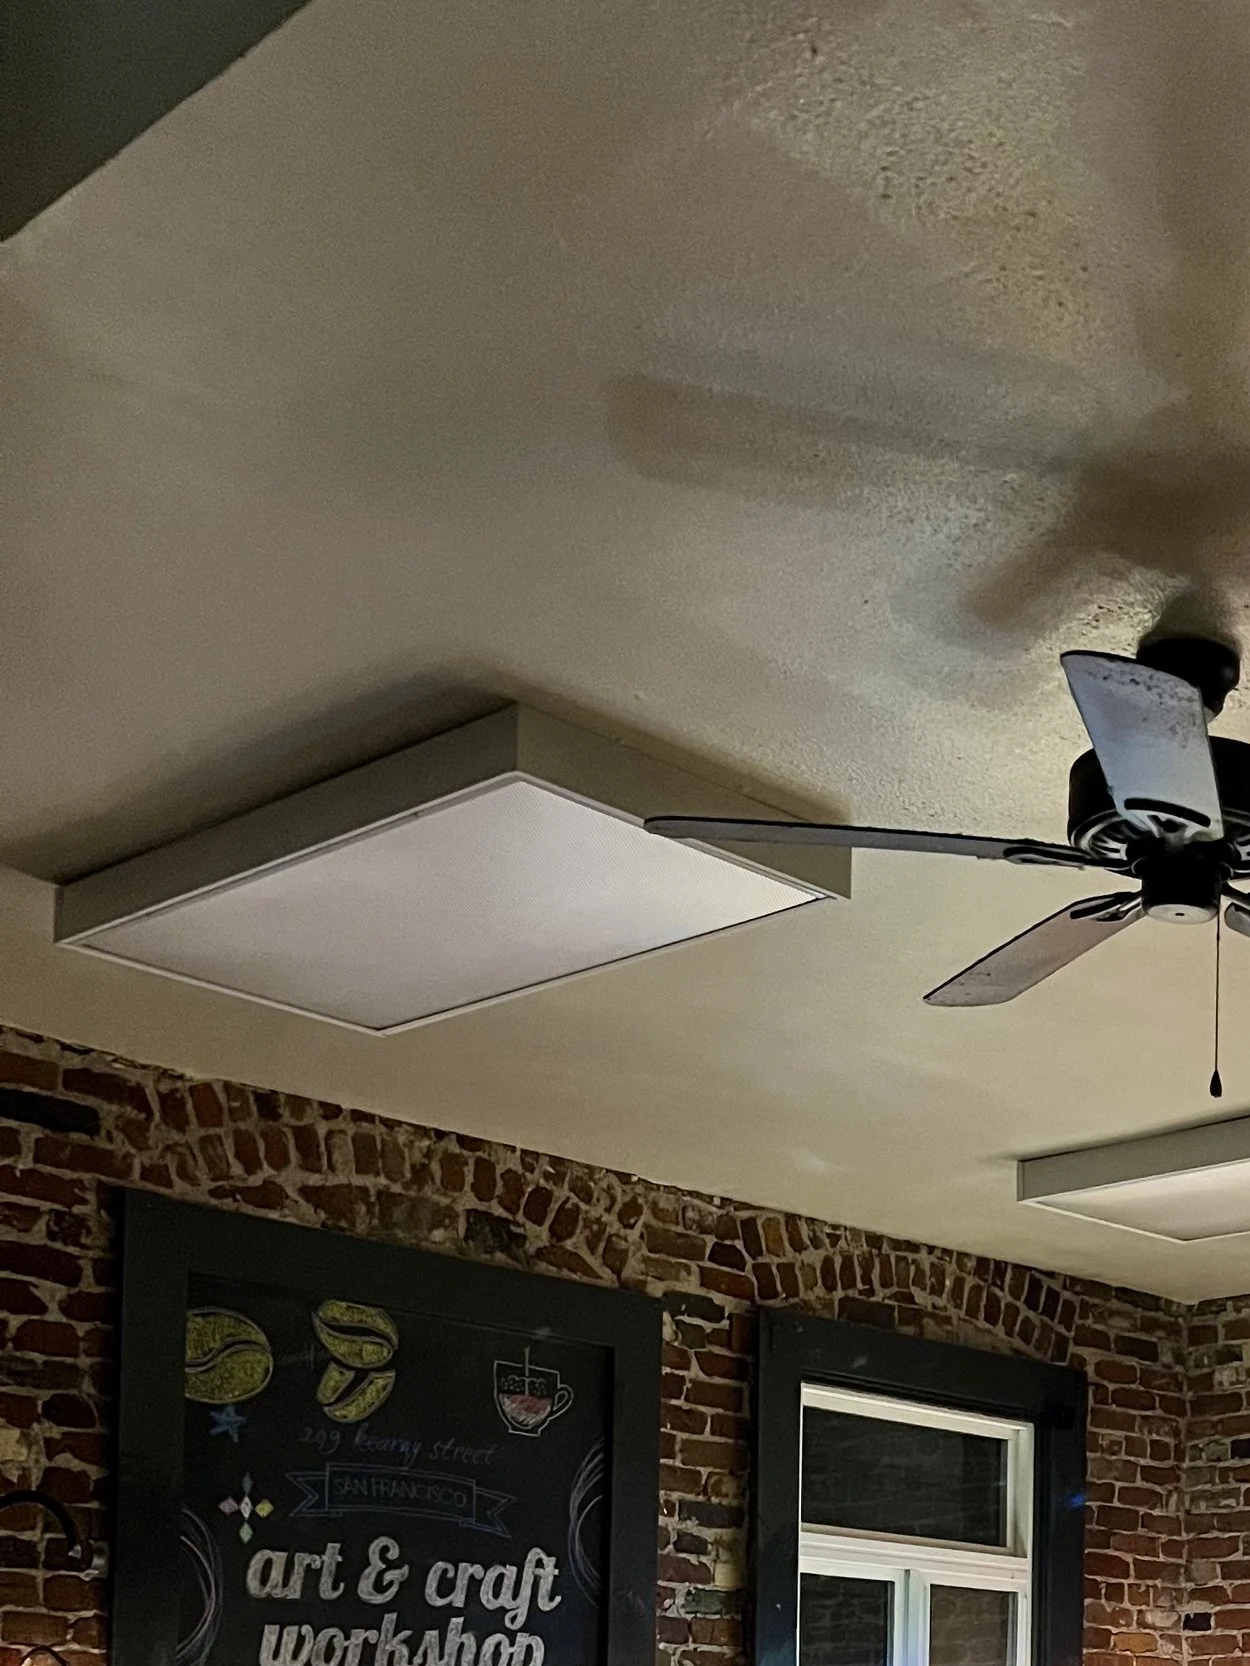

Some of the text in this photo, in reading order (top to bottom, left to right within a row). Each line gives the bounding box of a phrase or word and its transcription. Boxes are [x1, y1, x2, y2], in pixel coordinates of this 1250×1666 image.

[429, 1437, 499, 1465] street
[333, 1477, 468, 1508] SAN FRANCISCO
[246, 1536, 562, 1630] art & craft
